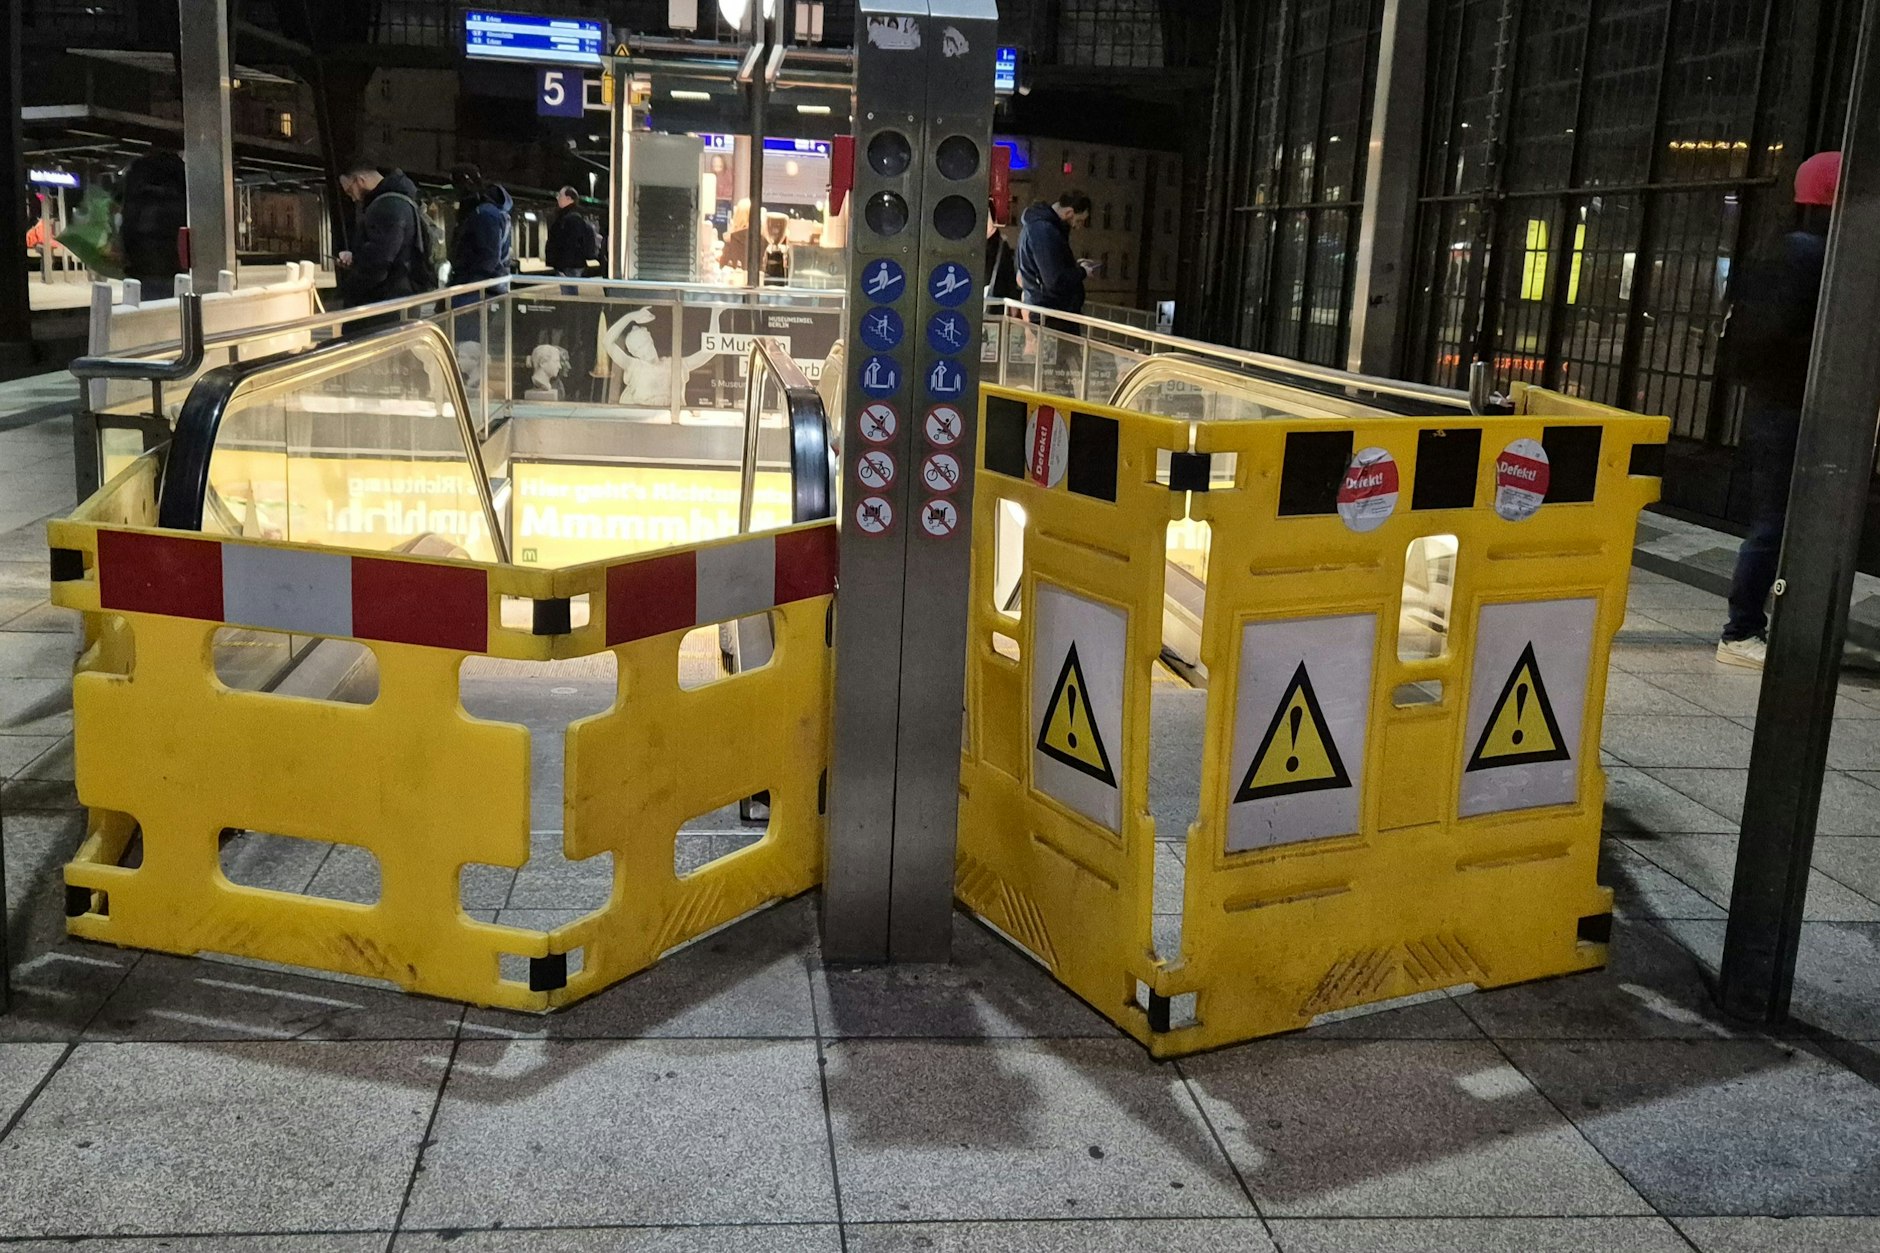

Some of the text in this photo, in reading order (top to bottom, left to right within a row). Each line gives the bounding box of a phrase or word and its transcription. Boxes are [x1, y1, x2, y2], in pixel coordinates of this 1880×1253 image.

[543, 71, 565, 106] 5
[705, 336, 786, 353] 5 Musn
[1500, 461, 1537, 482] Defekt!
[520, 478, 568, 497] Hier
